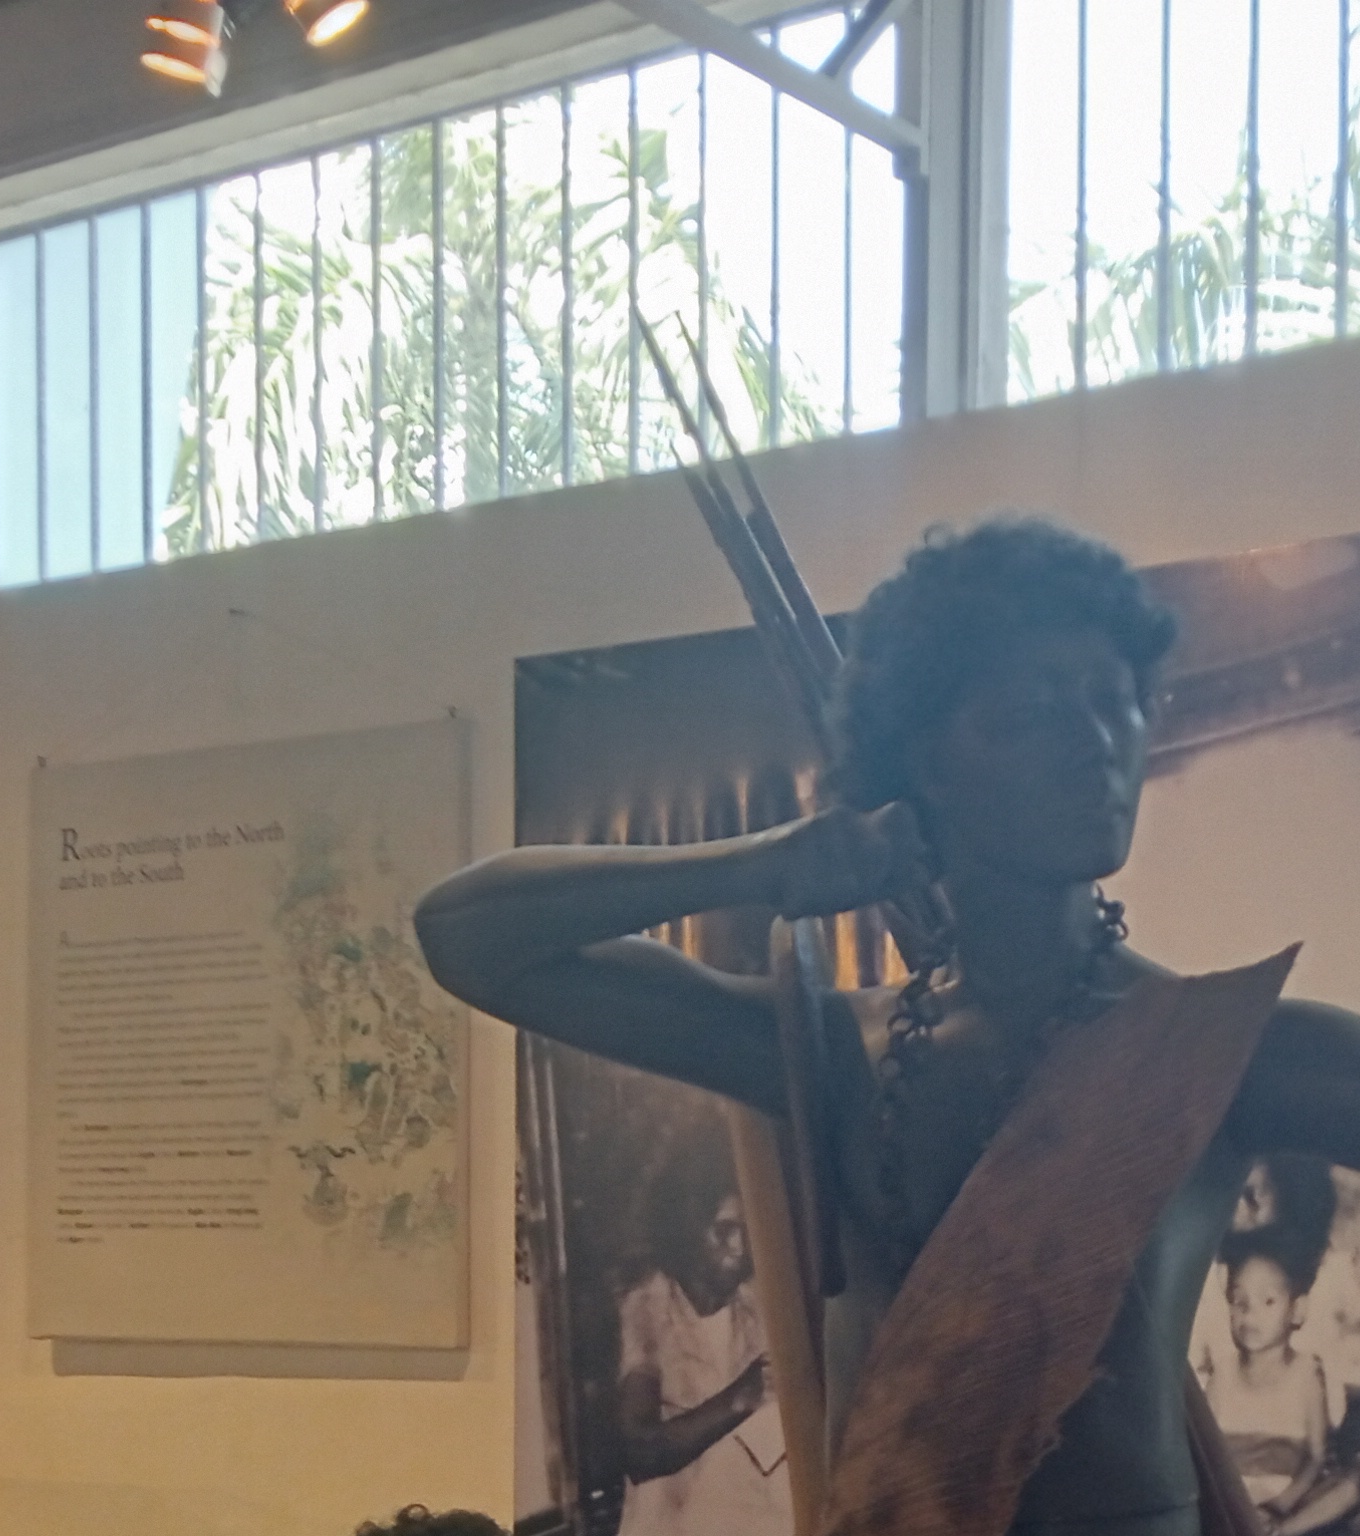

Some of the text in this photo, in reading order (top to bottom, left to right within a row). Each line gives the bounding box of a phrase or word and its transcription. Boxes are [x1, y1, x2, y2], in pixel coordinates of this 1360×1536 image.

[61, 820, 285, 862] Roots pointing to the North
[59, 860, 185, 890] and to the South
